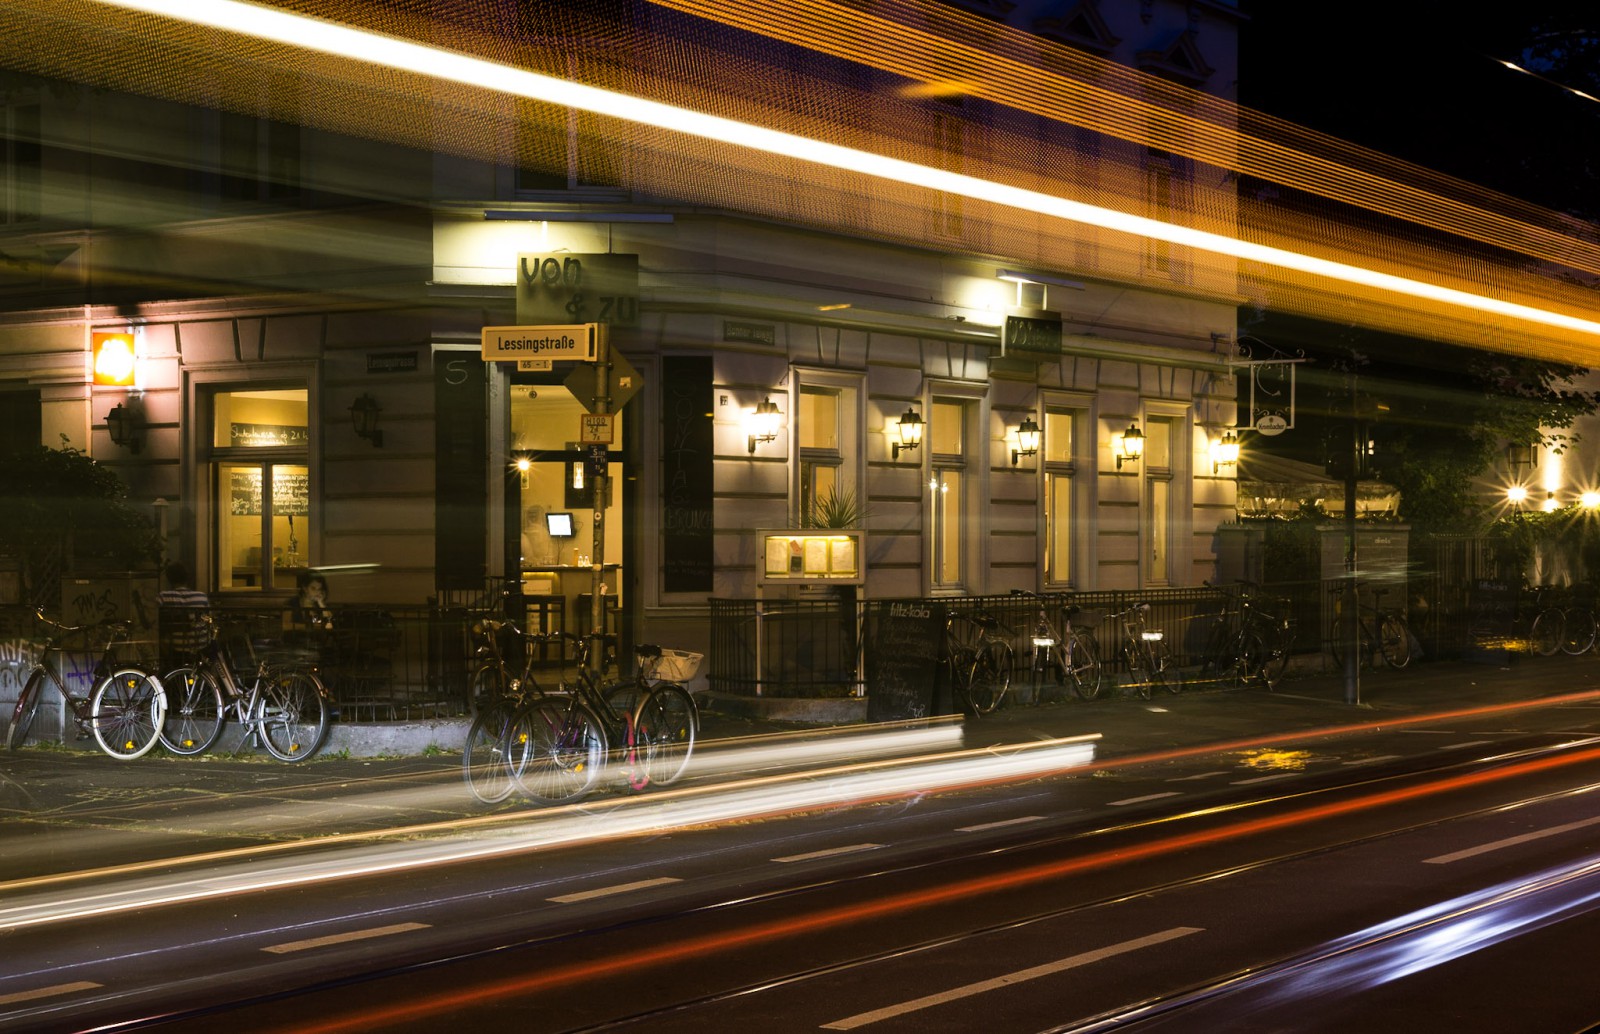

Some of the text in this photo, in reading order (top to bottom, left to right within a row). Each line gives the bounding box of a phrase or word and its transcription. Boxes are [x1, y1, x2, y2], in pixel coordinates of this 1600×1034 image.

[520, 257, 581, 288] von
[565, 293, 583, 315] &
[498, 335, 575, 354] Lessingstraße
[522, 361, 532, 369] 65
[890, 602, 931, 619] fritz-kola
